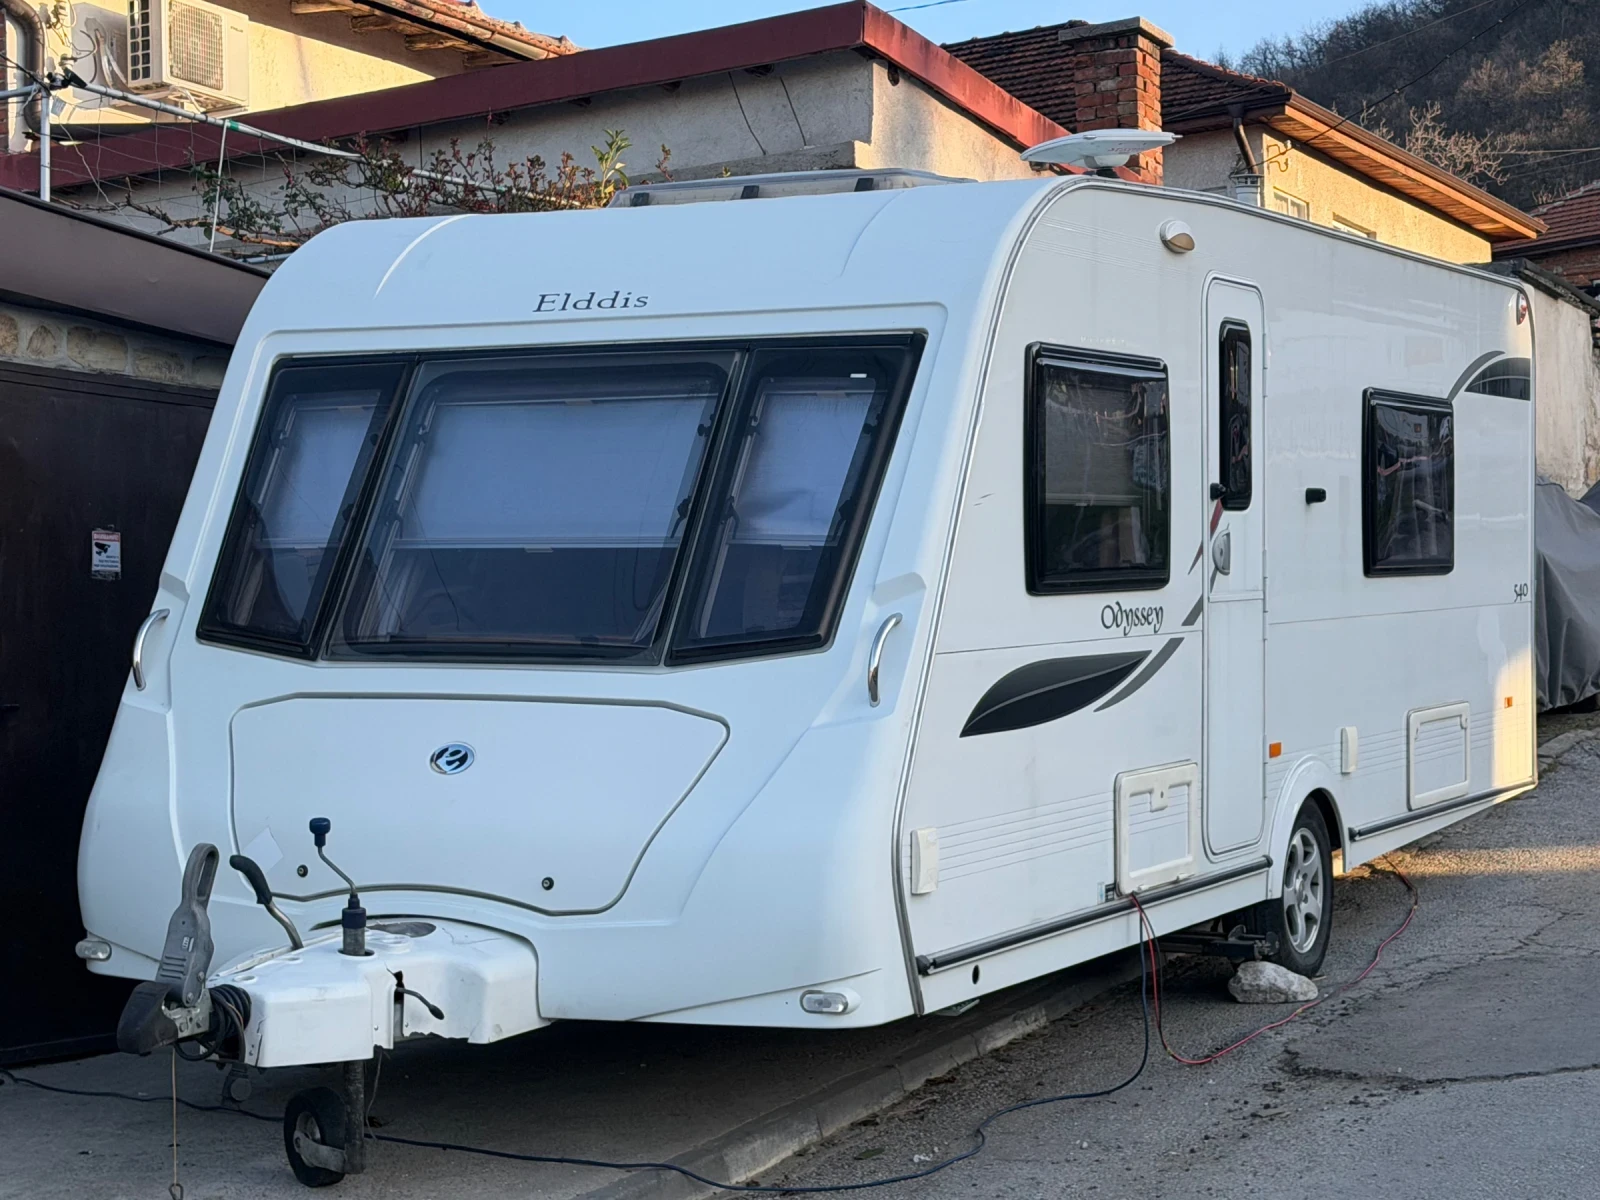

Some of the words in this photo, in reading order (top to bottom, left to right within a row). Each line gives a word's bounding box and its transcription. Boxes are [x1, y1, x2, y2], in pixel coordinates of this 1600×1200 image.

[532, 290, 649, 313] Elddis
[1513, 582, 1529, 603] 540
[1100, 600, 1164, 637] Odyssey
